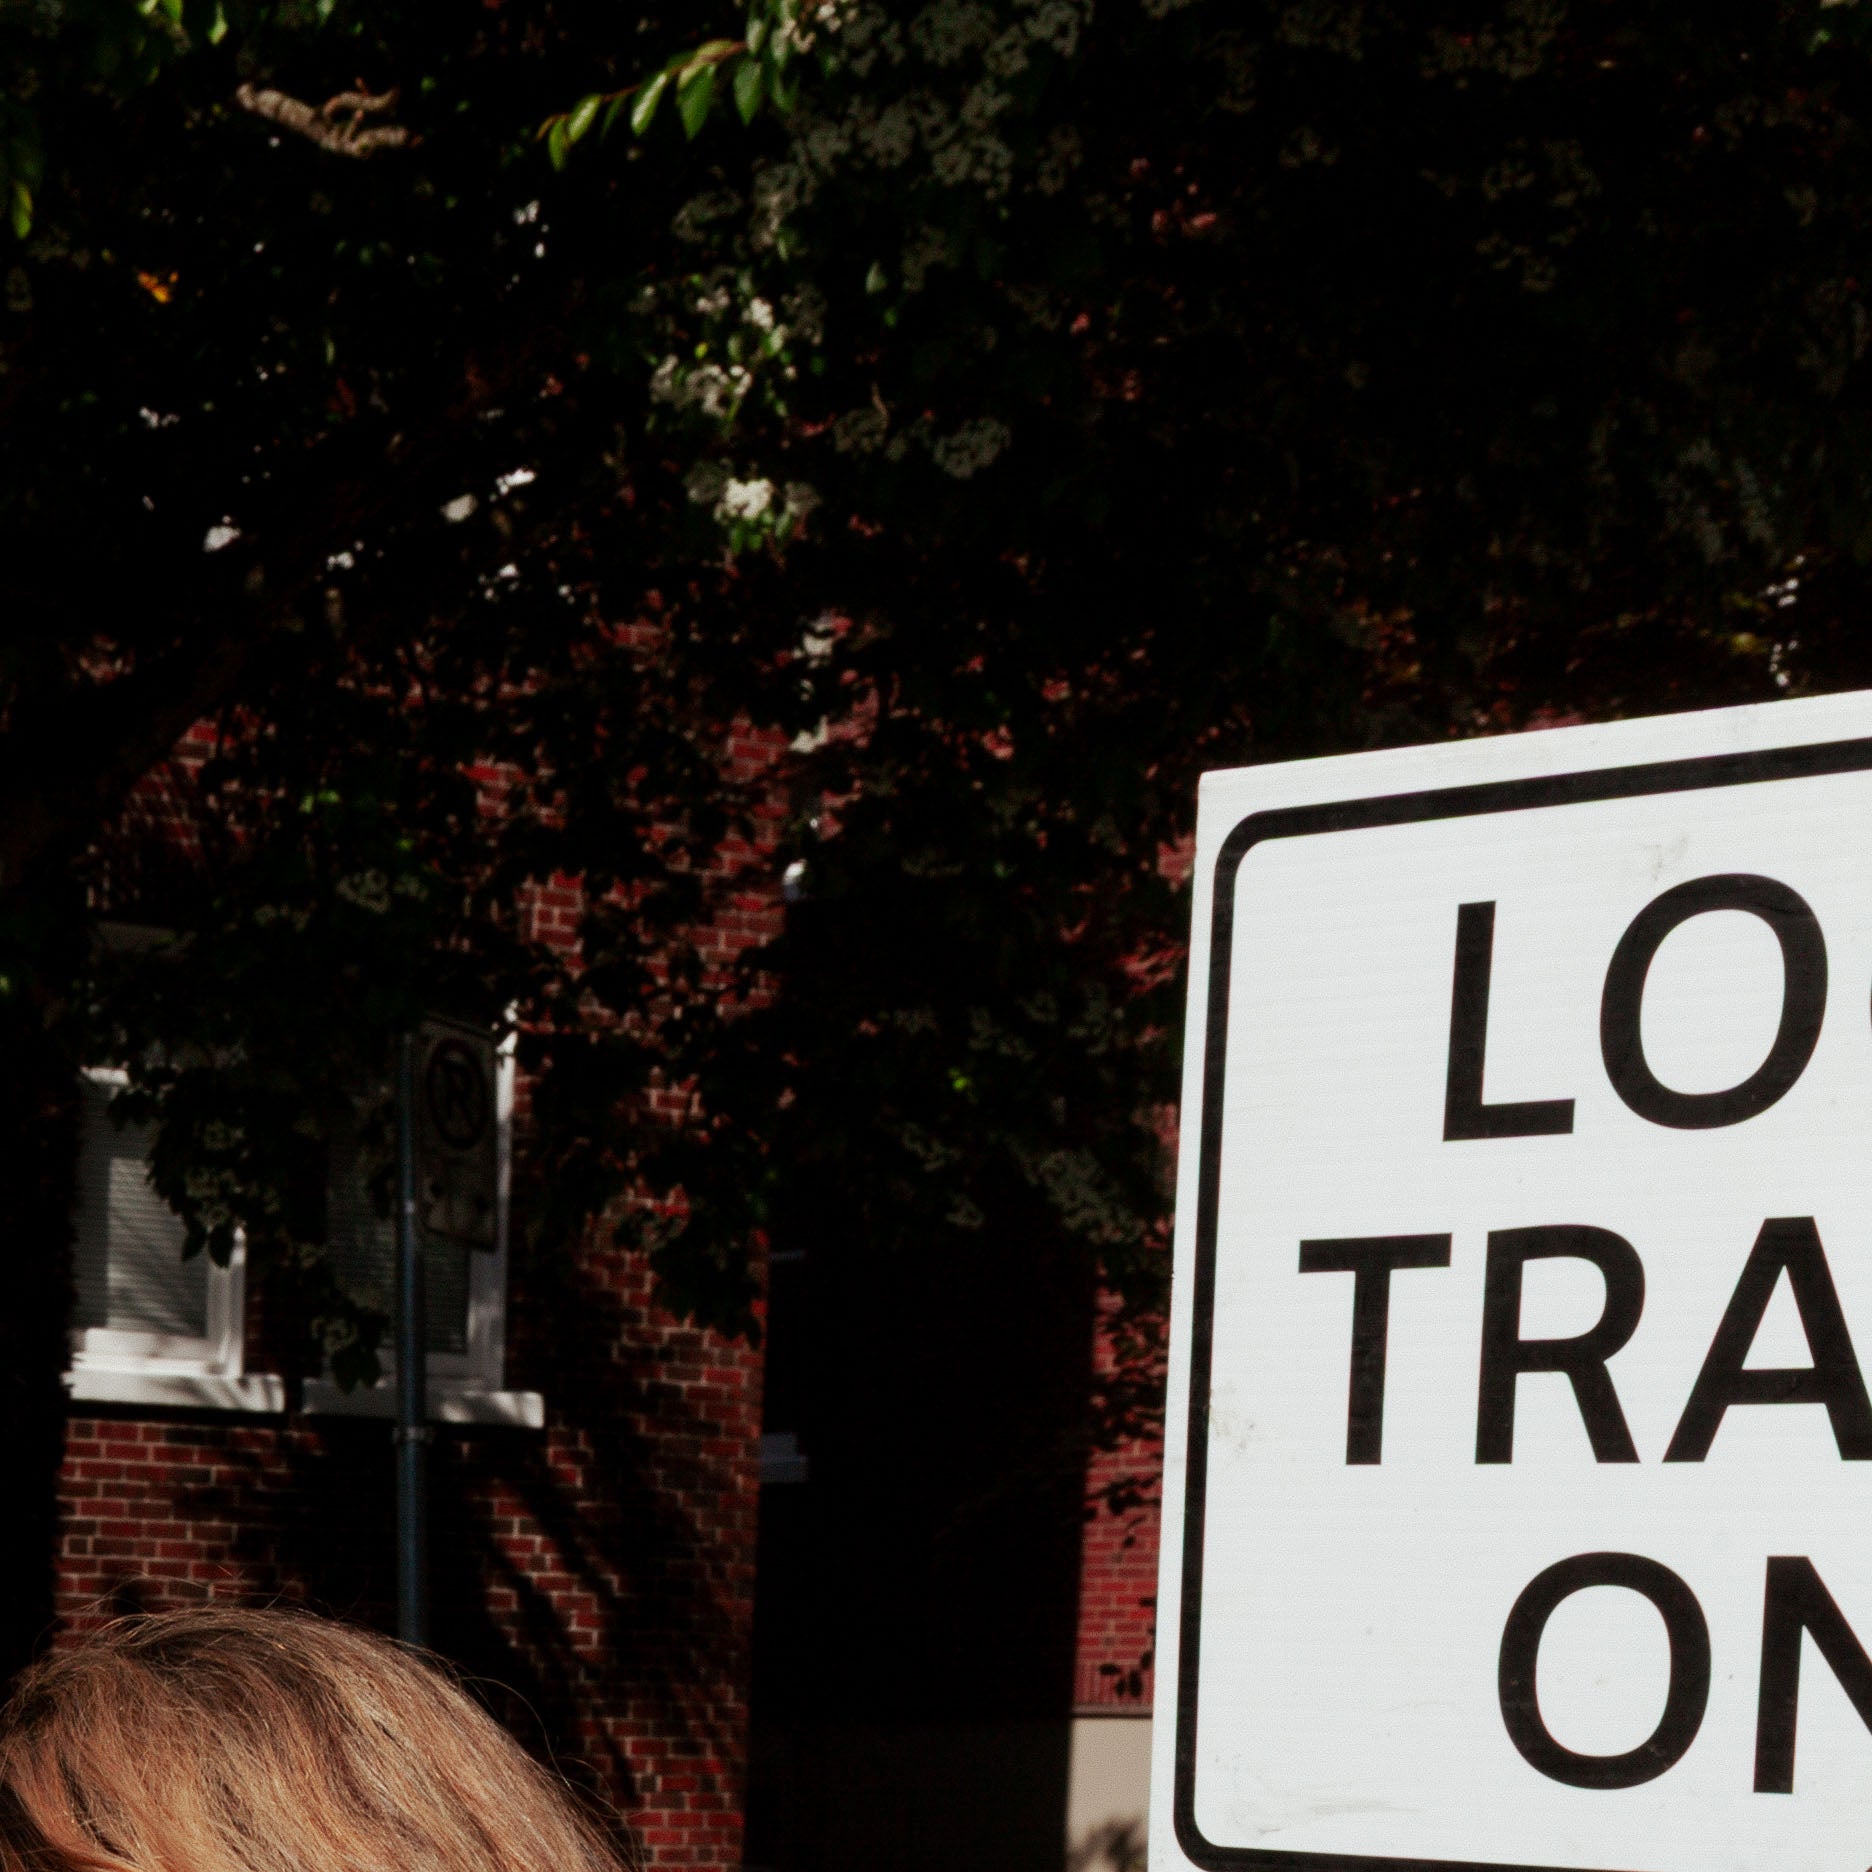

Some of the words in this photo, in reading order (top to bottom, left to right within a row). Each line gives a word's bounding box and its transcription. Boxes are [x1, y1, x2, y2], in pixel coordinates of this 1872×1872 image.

[1443, 873, 1872, 1142] LO
[1298, 1216, 1872, 1465] TRA
[1497, 1552, 1872, 1795] ON
